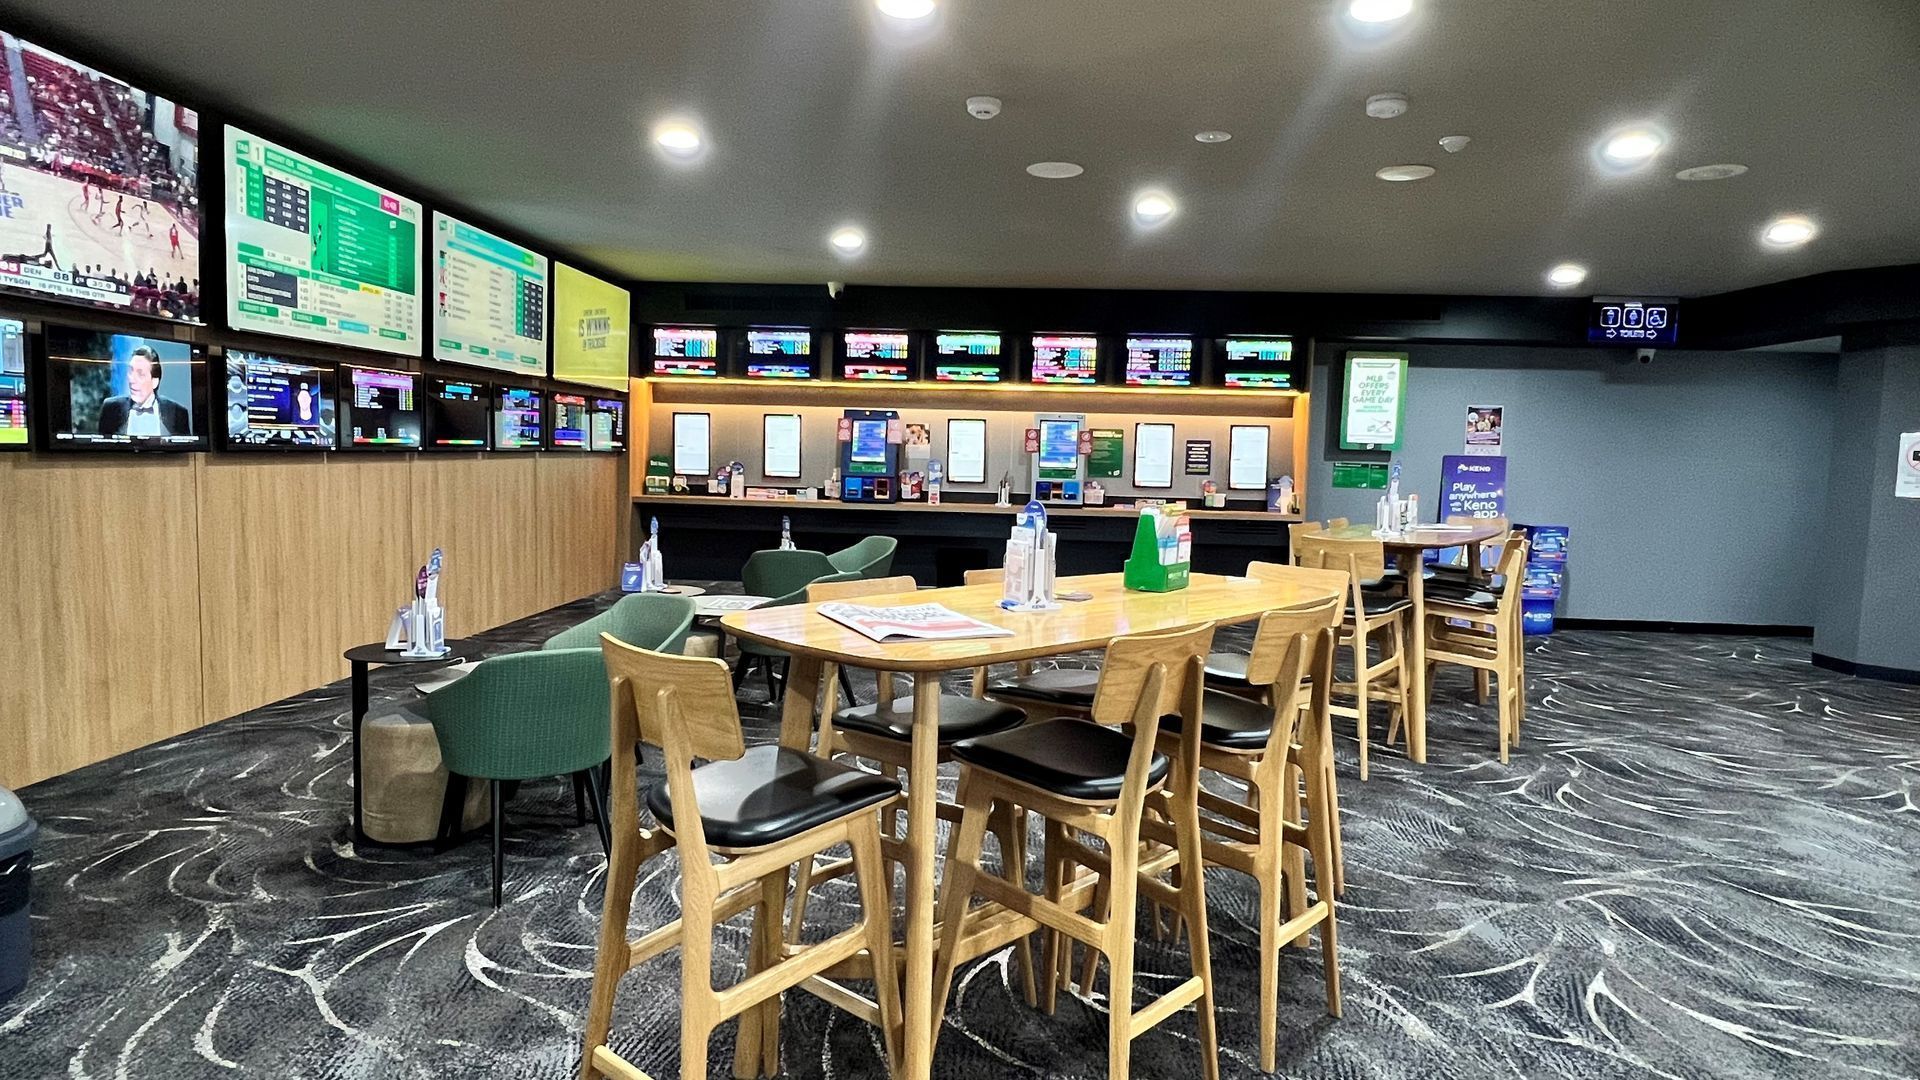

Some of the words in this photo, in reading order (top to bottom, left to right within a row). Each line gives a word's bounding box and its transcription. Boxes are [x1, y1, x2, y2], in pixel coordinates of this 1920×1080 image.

[23, 266, 42, 277] DEN
[53, 271, 69, 282] 88
[4, 276, 31, 287] TYSON
[76, 288, 91, 297] THIS
[92, 291, 106, 300] QTR
[1358, 382, 1390, 390] OFFERS
[1352, 396, 1377, 404] GAME
[1377, 396, 1395, 404] DAY
[1452, 481, 1476, 493] Play
[1448, 490, 1498, 502] anywhere
[1463, 500, 1498, 511] Keno
[1472, 510, 1499, 519] app
